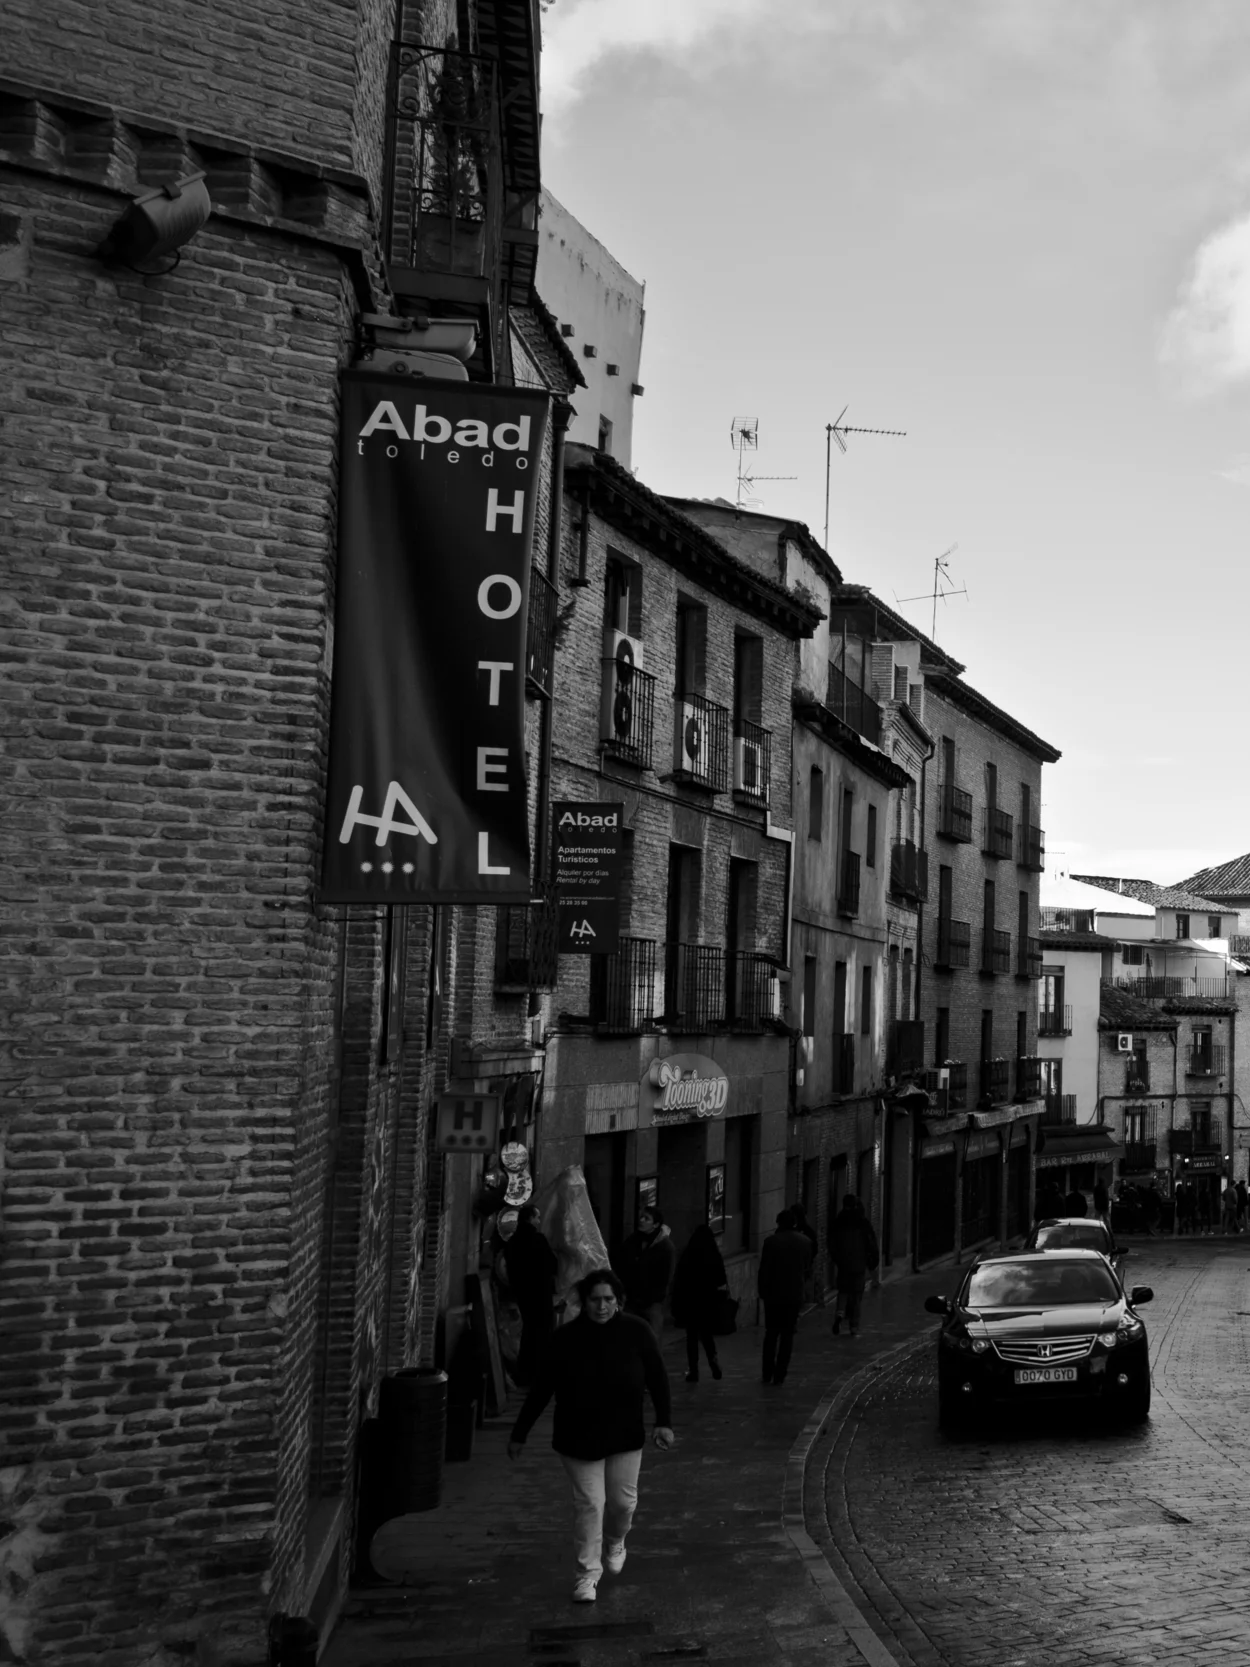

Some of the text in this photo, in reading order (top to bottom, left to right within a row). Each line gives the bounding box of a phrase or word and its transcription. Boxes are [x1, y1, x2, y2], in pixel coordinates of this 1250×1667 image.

[359, 400, 531, 451] Abad
[357, 439, 529, 470] toledo
[476, 487, 525, 876] HOTEL
[559, 811, 618, 827] Abad
[558, 826, 618, 834] toledo
[557, 845, 617, 855] Apartamentos
[582, 869, 594, 878] por
[578, 877, 588, 886] by
[588, 877, 602, 886] day
[454, 1101, 483, 1131] H
[1040, 1156, 1058, 1168] BAR
